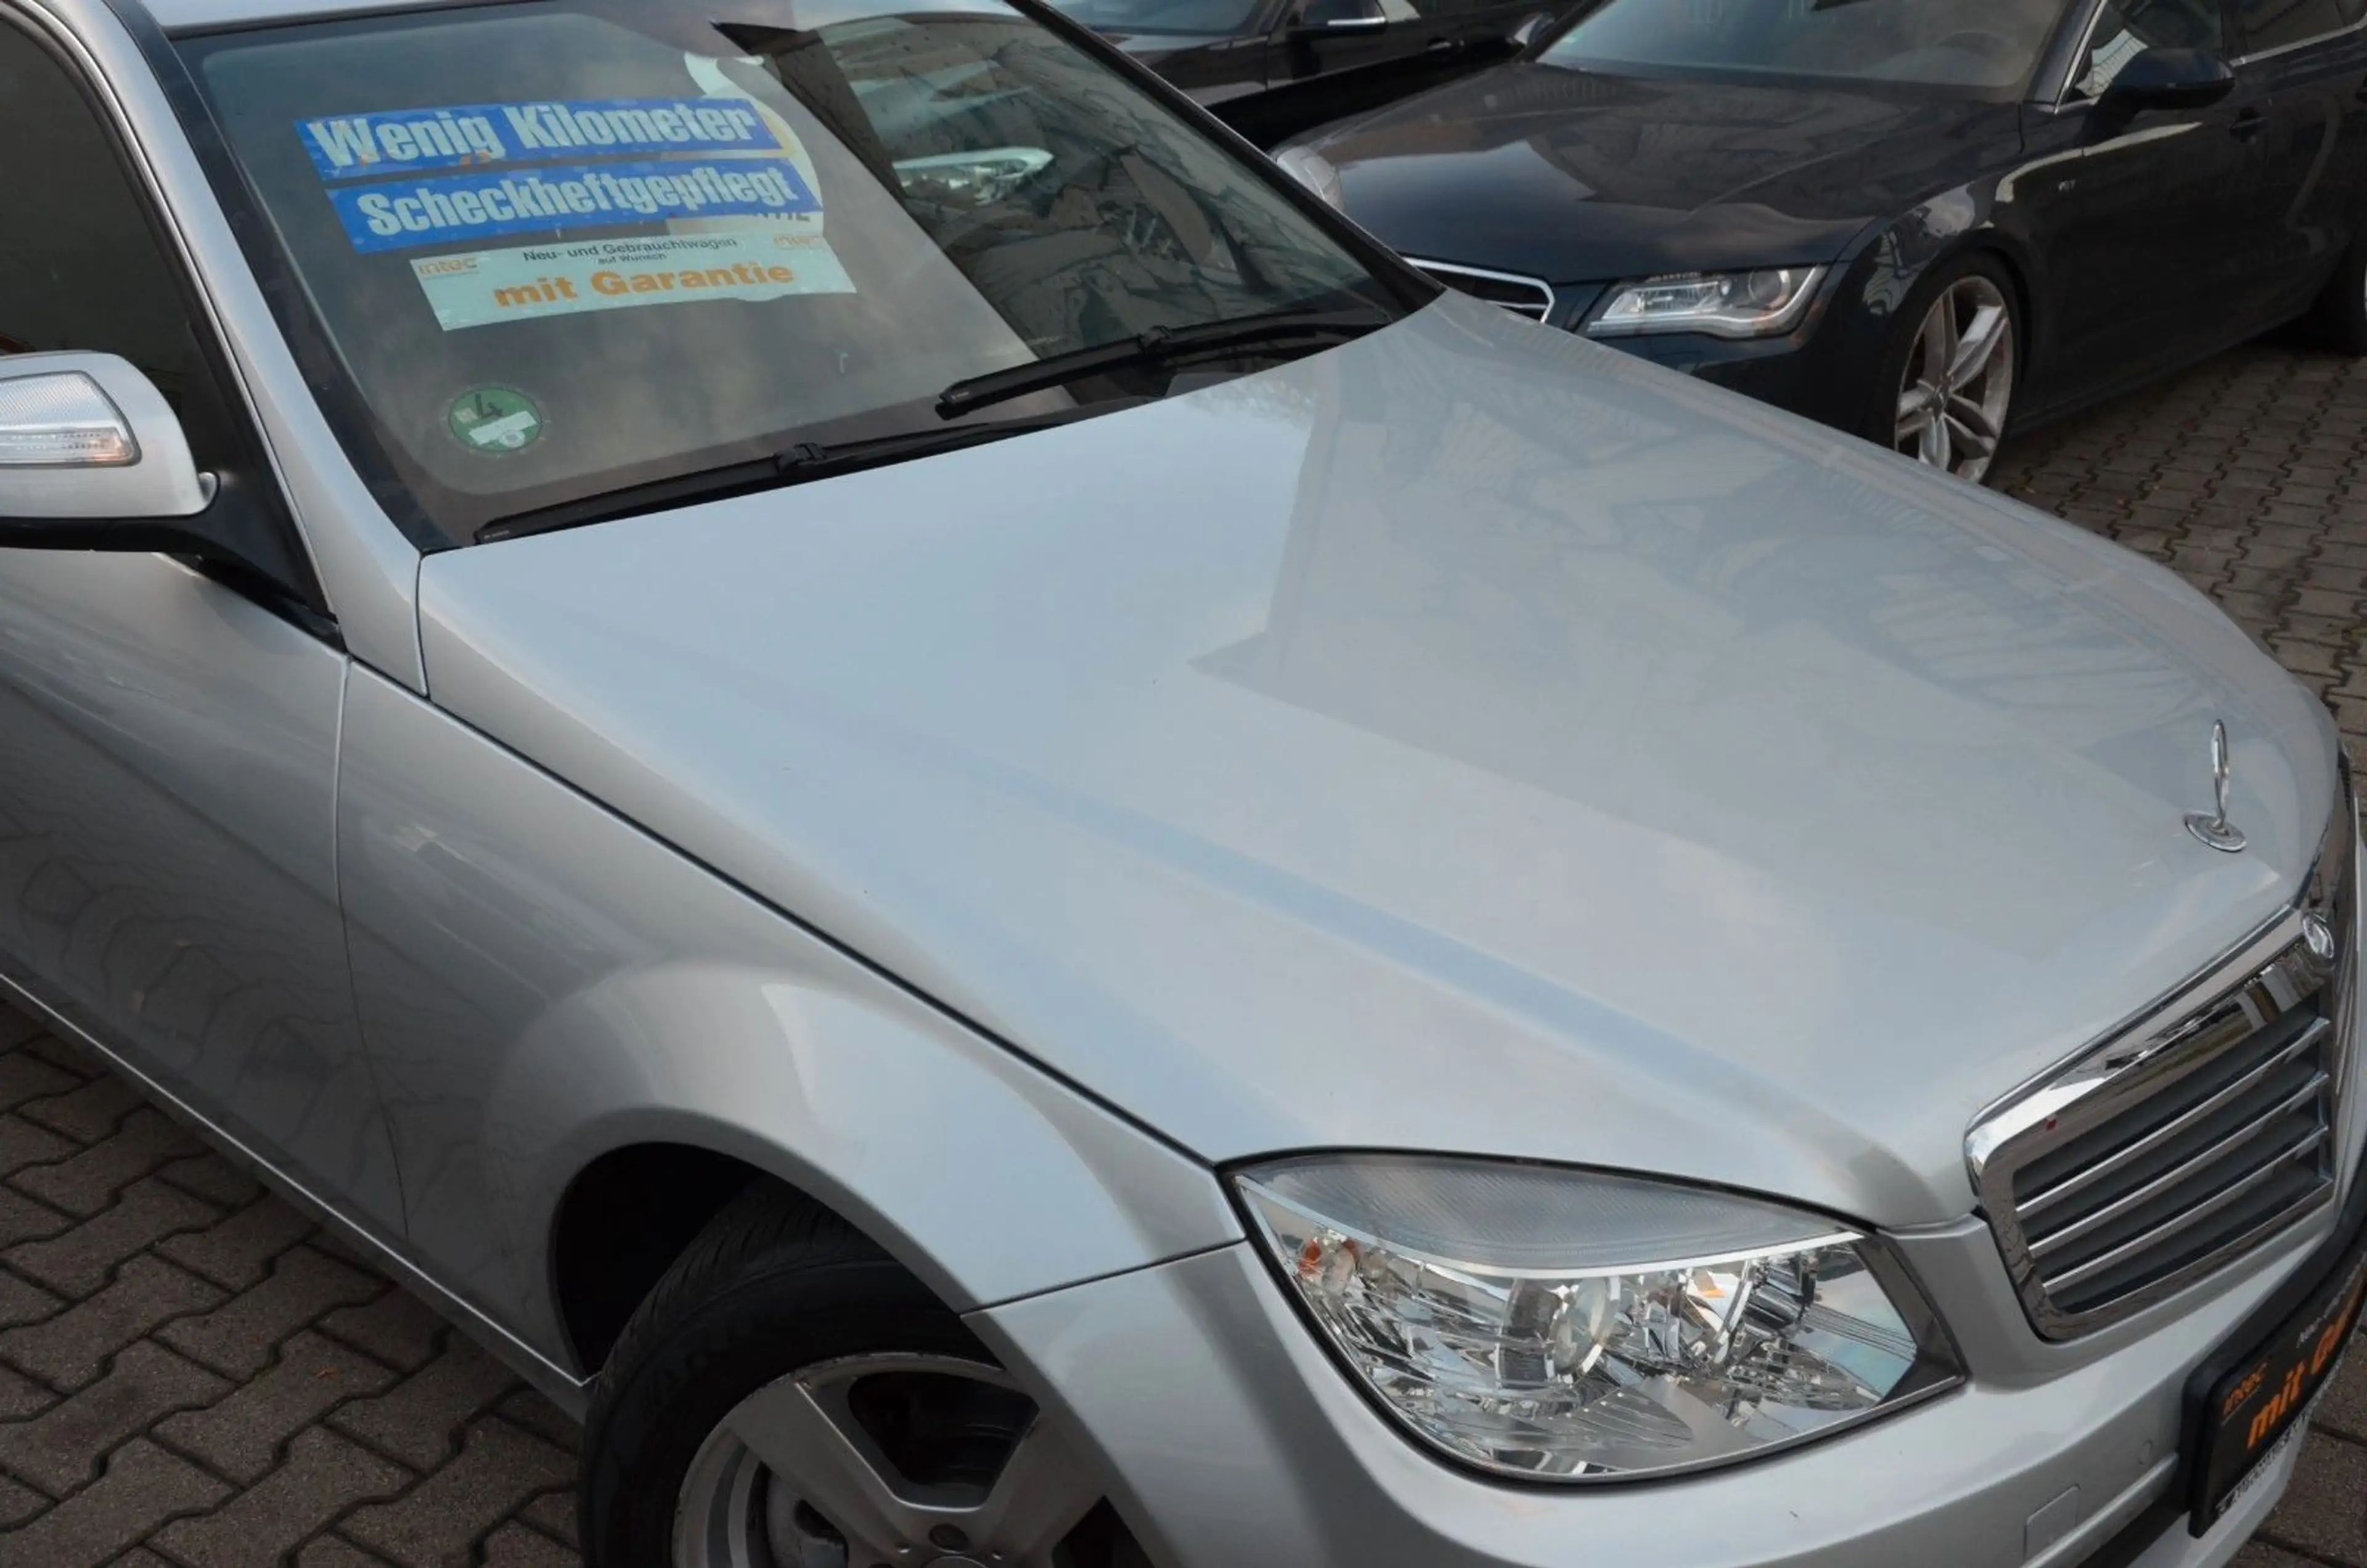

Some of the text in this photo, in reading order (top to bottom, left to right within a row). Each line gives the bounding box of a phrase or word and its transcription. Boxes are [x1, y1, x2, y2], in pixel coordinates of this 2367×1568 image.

[306, 103, 756, 166] Wenig Kilometer
[357, 166, 799, 235] Scheckheftgepflegt
[523, 250, 564, 261] Neu-
[567, 245, 600, 258] und
[493, 260, 794, 306] mit Garantie
